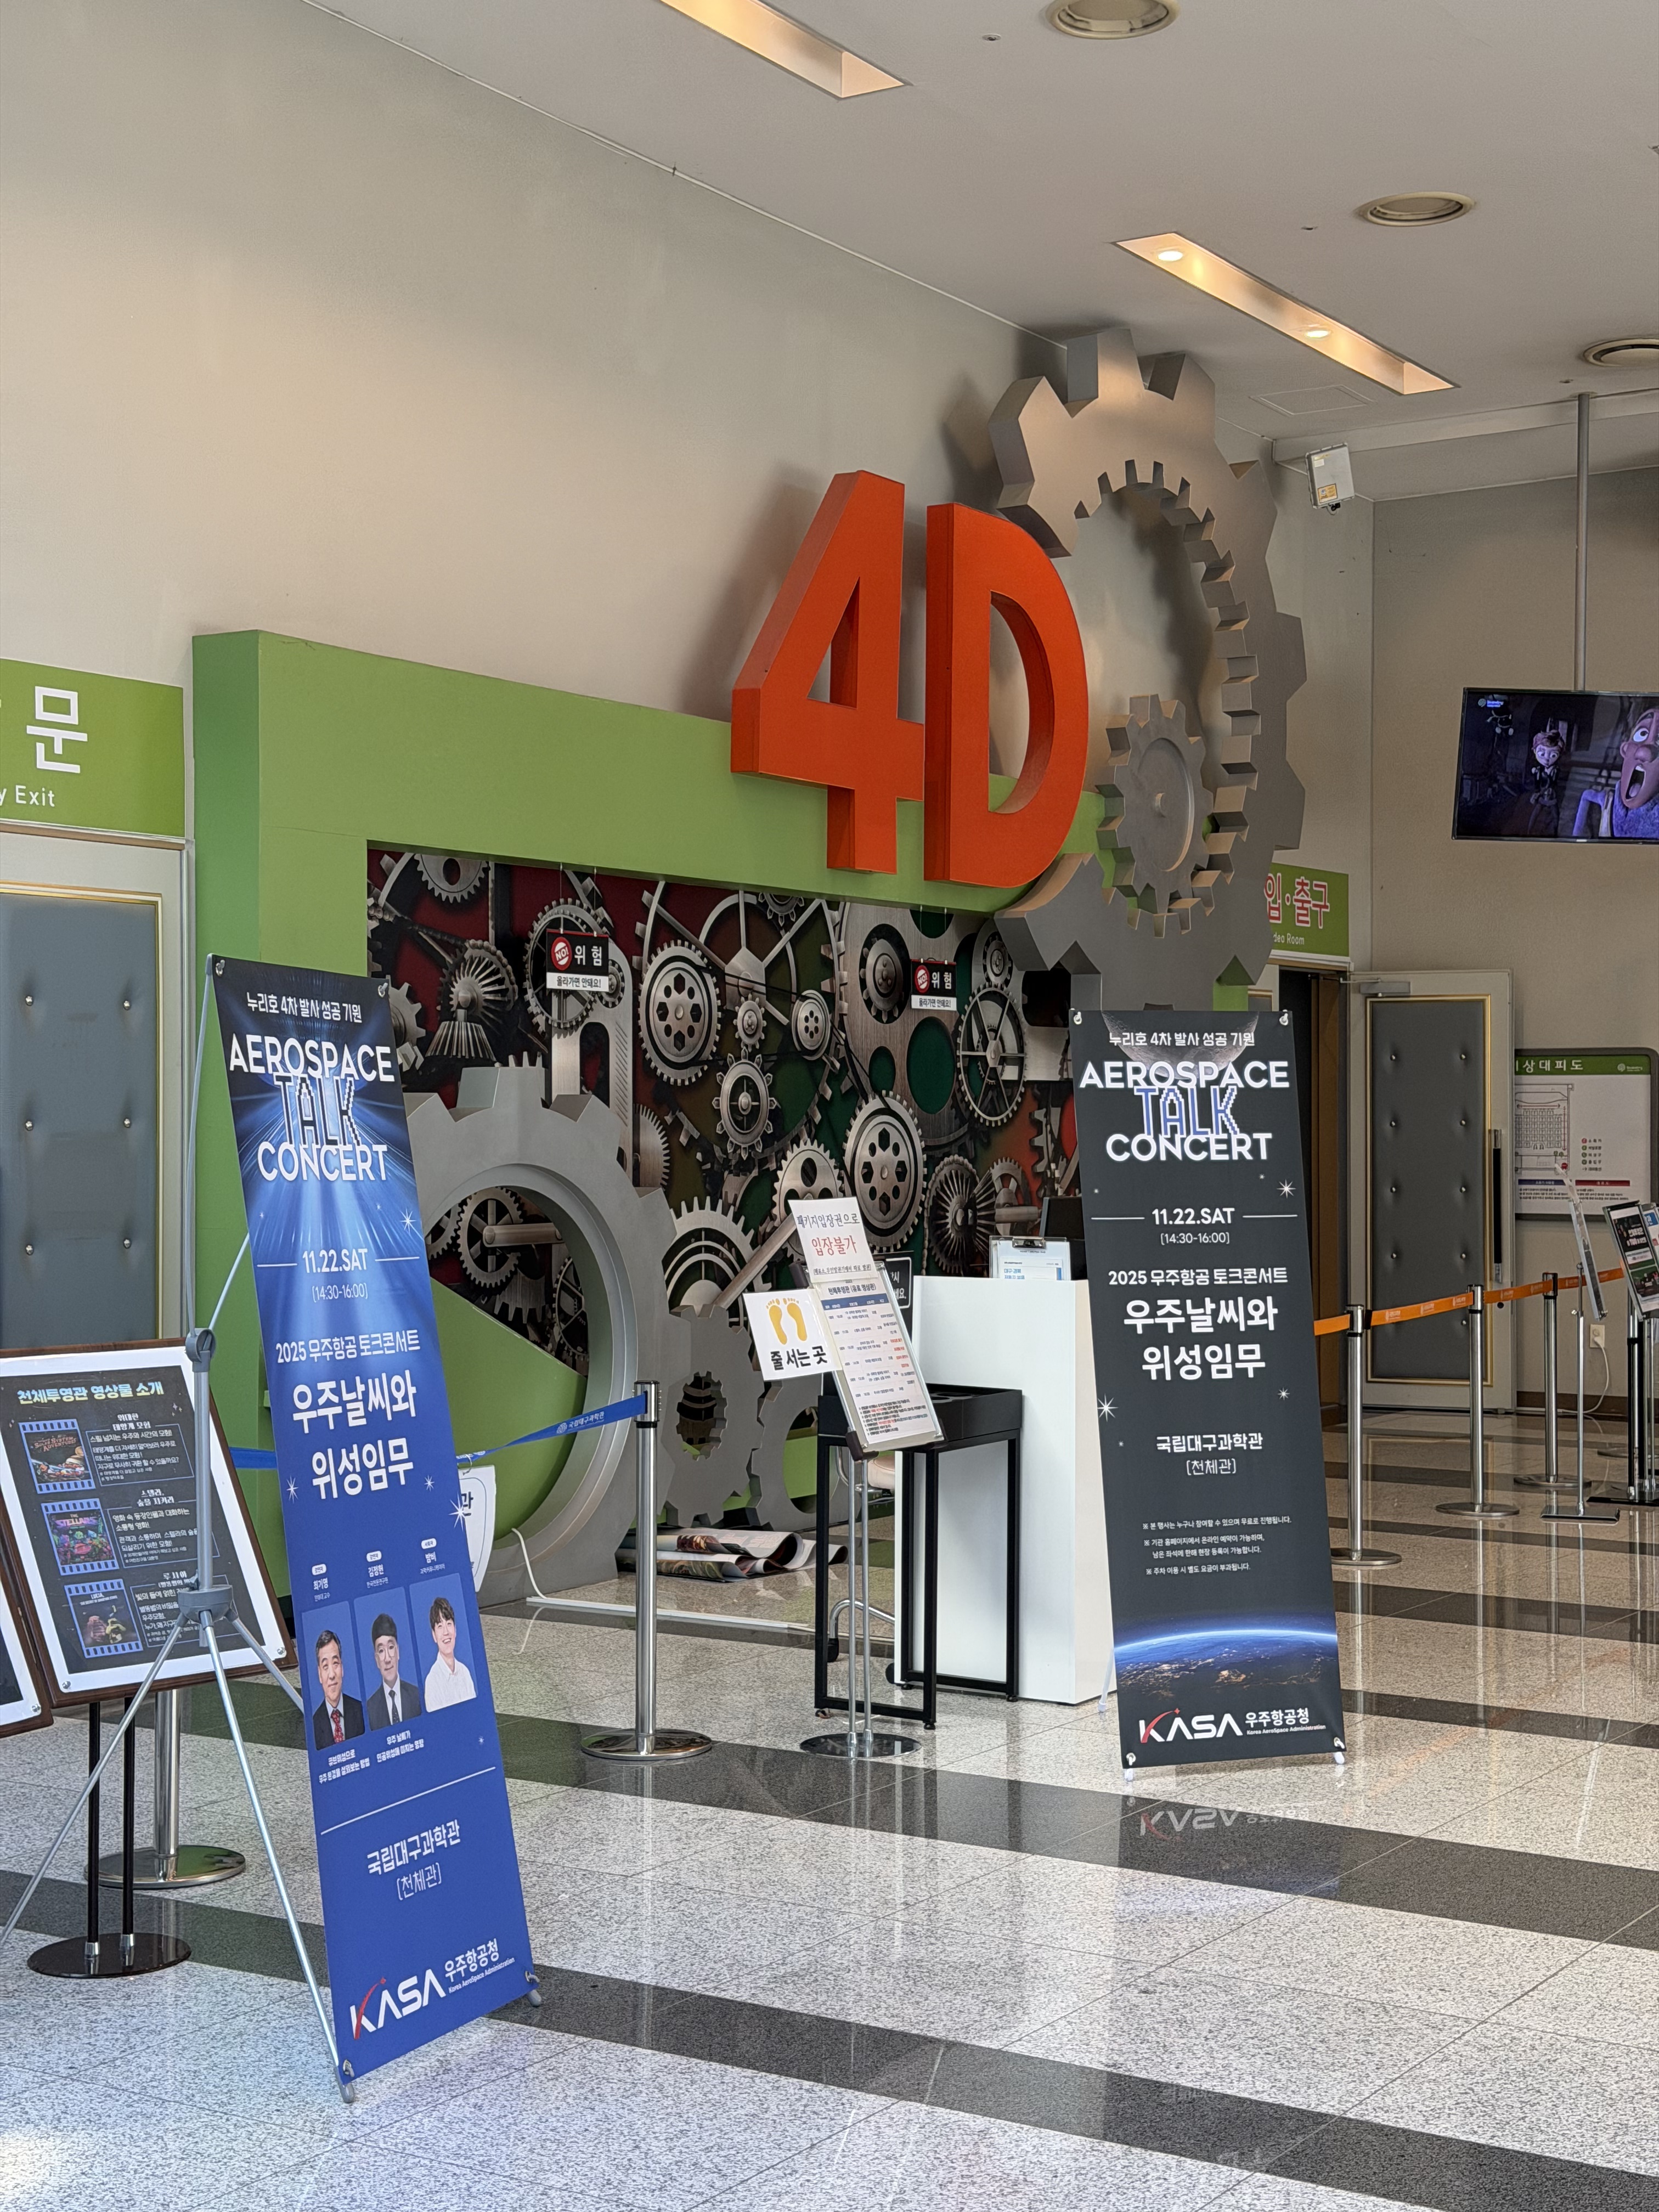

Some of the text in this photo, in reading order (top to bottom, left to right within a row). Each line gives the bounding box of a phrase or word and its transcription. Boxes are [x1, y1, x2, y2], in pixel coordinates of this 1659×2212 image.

[730, 470, 1089, 889] 4D
[26, 686, 88, 774] 문
[16, 785, 55, 807] Exit
[1273, 932, 1305, 945] deo Room
[555, 946, 569, 961] NO!
[557, 975, 601, 988] 올라가면 안돼요!
[917, 973, 928, 985] NO!
[247, 992, 363, 1024] 누리호 4차 발사 성공 기원
[919, 998, 936, 1007] 올라가면
[1109, 1032, 1255, 1046] 누리호 4차 발사 성공 기원
[229, 1032, 395, 1082] AEROSPACE
[1516, 1059, 1583, 1073] 상대피도
[1079, 1060, 1290, 1088] AEROSPACE
[273, 1072, 361, 1147] TALK
[1134, 1085, 1240, 1138] TALK
[1106, 1133, 1272, 1161] CONCERT
[257, 1140, 388, 1182] CONCERT
[797, 1213, 860, 1228] 패키지입장권으로
[1152, 1207, 1235, 1225] 11.22.SAT
[811, 1235, 857, 1256] 입장불가
[302, 1248, 368, 1273] 11.22.SAT
[1109, 1267, 1288, 1286] 2025 우주항공 토크콘서트
[828, 1283, 877, 1295] 천체투영관 (유료 영상관)
[1124, 1296, 1278, 1334] 우주날씨와
[275, 1329, 421, 1363] 2025 우주항공 토크콘서트
[770, 1351, 784, 1370] 줄
[786, 1348, 811, 1368] 서는
[812, 1345, 828, 1365] 곳
[1142, 1343, 1266, 1381] 위성임무
[17, 1381, 164, 1404] 천체투영관 영상물 소개
[292, 1369, 417, 1434] 우주날씨와
[112, 1421, 151, 1431] 태양계 모험
[1156, 1432, 1263, 1453] 국립대구과학관
[312, 1437, 414, 1500] 위성임무
[112, 1514, 126, 1522] 영화
[165, 1508, 190, 1516] 대화하는
[1176, 1520, 1194, 1528] 누구나
[1195, 1519, 1214, 1528] 참여할
[1222, 1518, 1240, 1526] 있으며
[1241, 1517, 1260, 1525] 무료로
[1260, 1516, 1291, 1525] 진행됩니다.
[138, 1532, 161, 1541] 소통하며
[1151, 1538, 1164, 1547] 기관
[1165, 1536, 1200, 1546] 홈페이지에서
[1201, 1536, 1219, 1544] 온라인
[1239, 1533, 1265, 1542] 가능하며,
[1152, 1550, 1165, 1559] 남은
[1184, 1549, 1197, 1557] 한해
[1198, 1548, 1210, 1556] 현장
[1211, 1547, 1229, 1556] 등록이
[1230, 1545, 1261, 1554] 가능합니다.
[1166, 1566, 1179, 1575] 이용
[1180, 1566, 1187, 1574] 시
[1187, 1565, 1200, 1573] 별도
[1201, 1564, 1218, 1572] 요금이
[1220, 1562, 1251, 1572] 부과됩니다.
[1139, 1707, 1243, 1743] KASA
[1245, 1707, 1309, 1728] 우주항공청
[1290, 1724, 1327, 1732] Administration
[386, 1730, 411, 1745] 우주 날씨가
[328, 1749, 356, 1767] 큐브위성으로
[376, 1739, 424, 1763] 인공위성에 미치는 영향
[319, 1773, 328, 1784] 우주
[367, 1819, 461, 1875] 국립대구과학관
[444, 1938, 500, 1982] 우주항공청
[448, 1957, 515, 1994] Korea AeroSpace Administration
[349, 1968, 447, 2040] KASA
